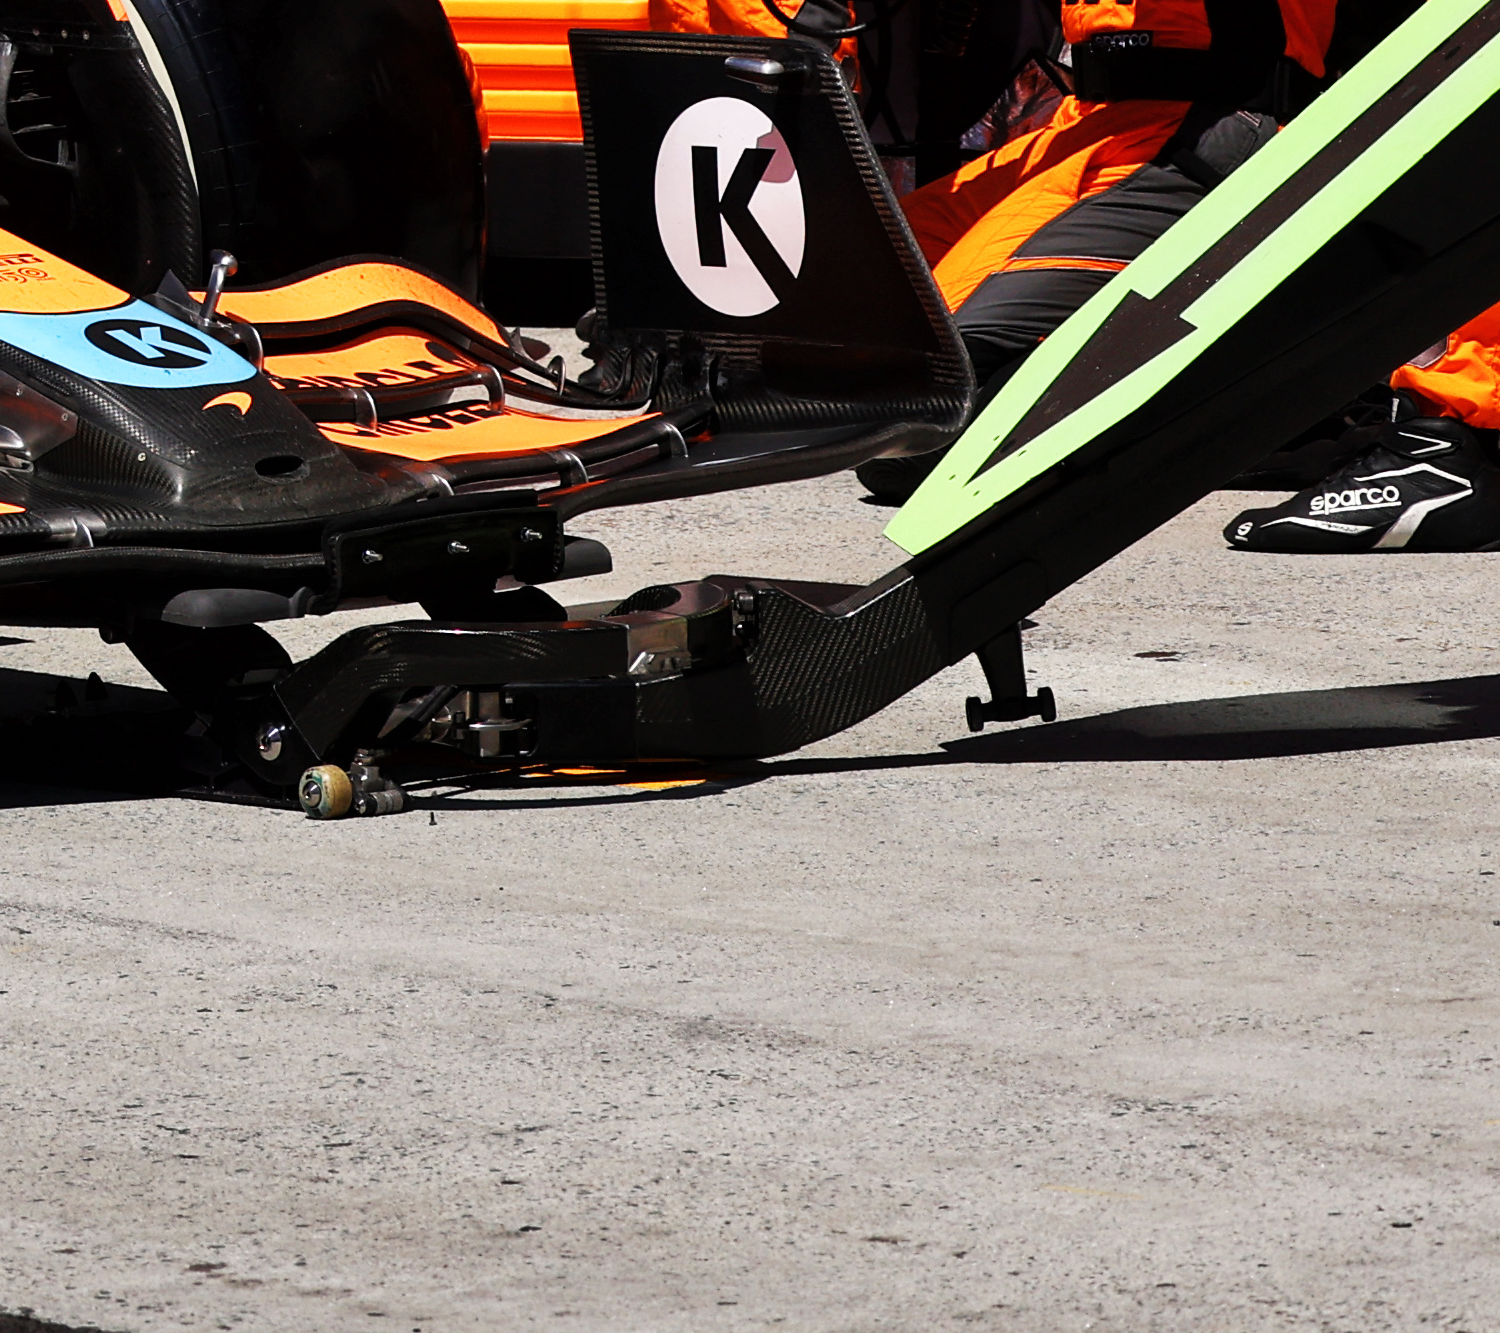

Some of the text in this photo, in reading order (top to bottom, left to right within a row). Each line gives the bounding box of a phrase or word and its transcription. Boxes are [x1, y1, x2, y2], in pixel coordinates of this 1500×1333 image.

[689, 144, 799, 307] K
[104, 325, 213, 361] K
[1310, 485, 1401, 516] sparco
